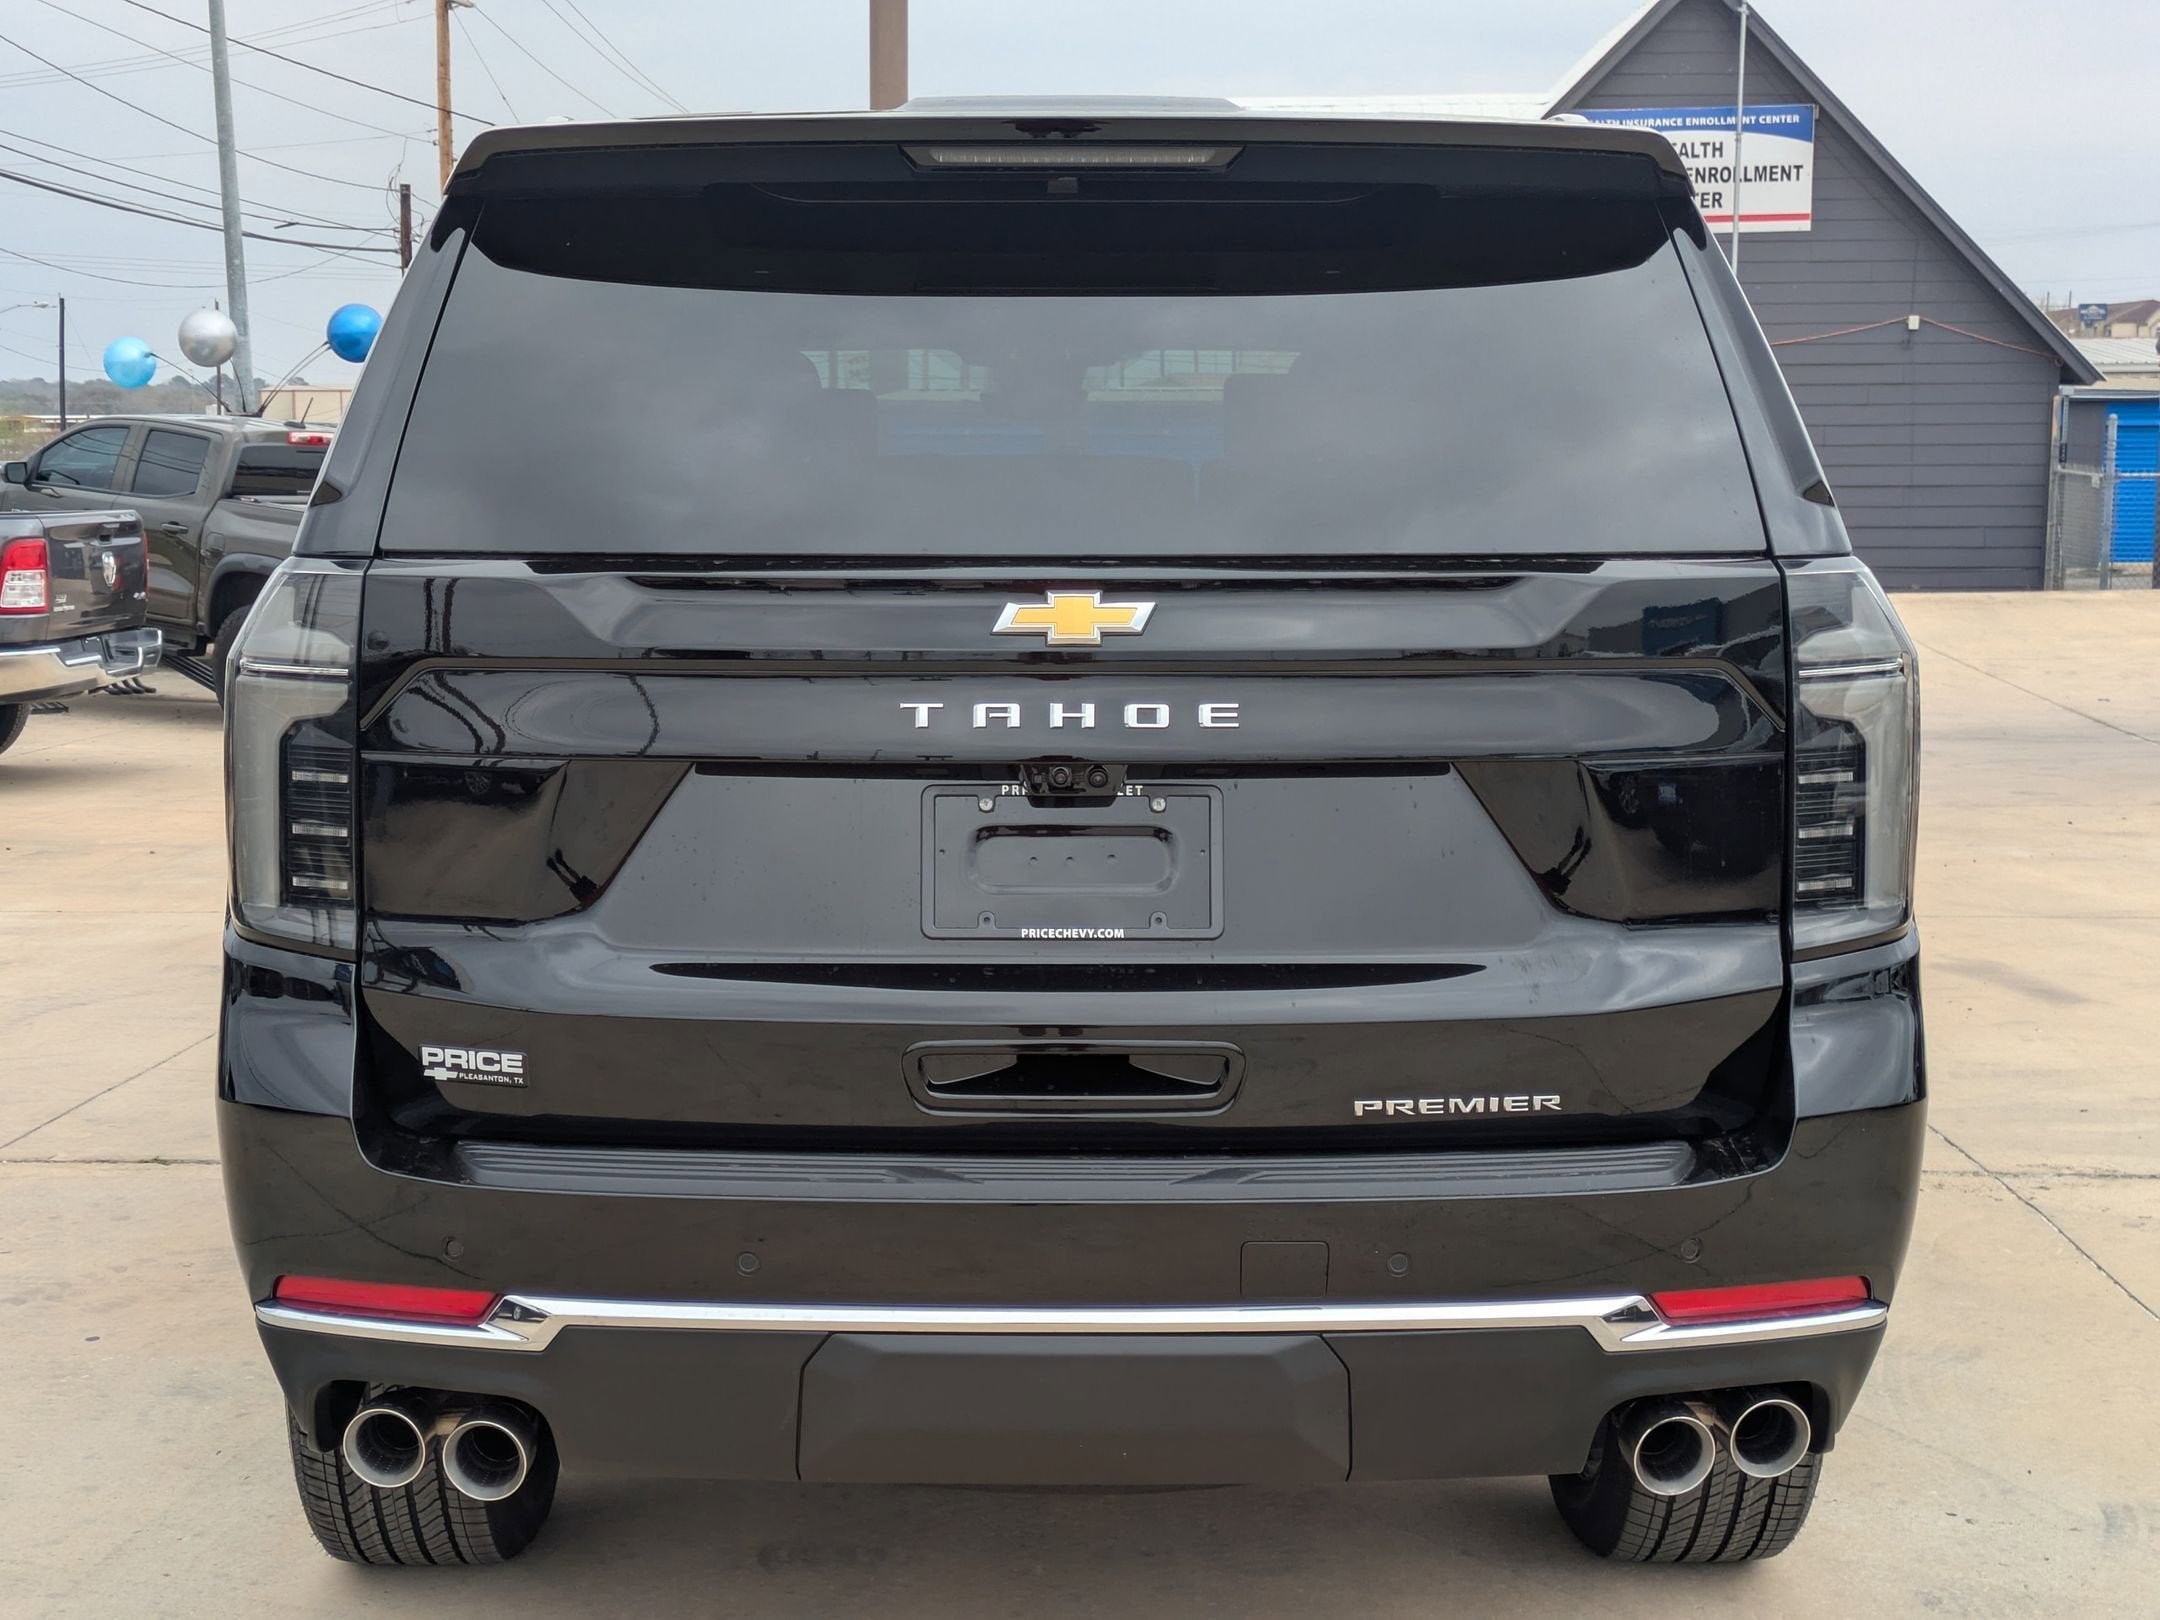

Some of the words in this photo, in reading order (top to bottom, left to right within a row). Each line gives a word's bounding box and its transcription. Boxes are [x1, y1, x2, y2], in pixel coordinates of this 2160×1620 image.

[1622, 117, 1682, 127] INSURANCE
[1686, 116, 1757, 126] ENROLLMNT
[1759, 115, 1800, 124] CENTER
[1673, 142, 1723, 159] ALTH
[1696, 191, 1722, 209] ER
[900, 703, 1240, 729] TAHOE
[1021, 928, 1125, 940] PRICECHEVY.COM
[421, 1046, 524, 1074] PRICE
[459, 1072, 512, 1084] PLEASANTON,
[1354, 1095, 1562, 1117] PREMIER
